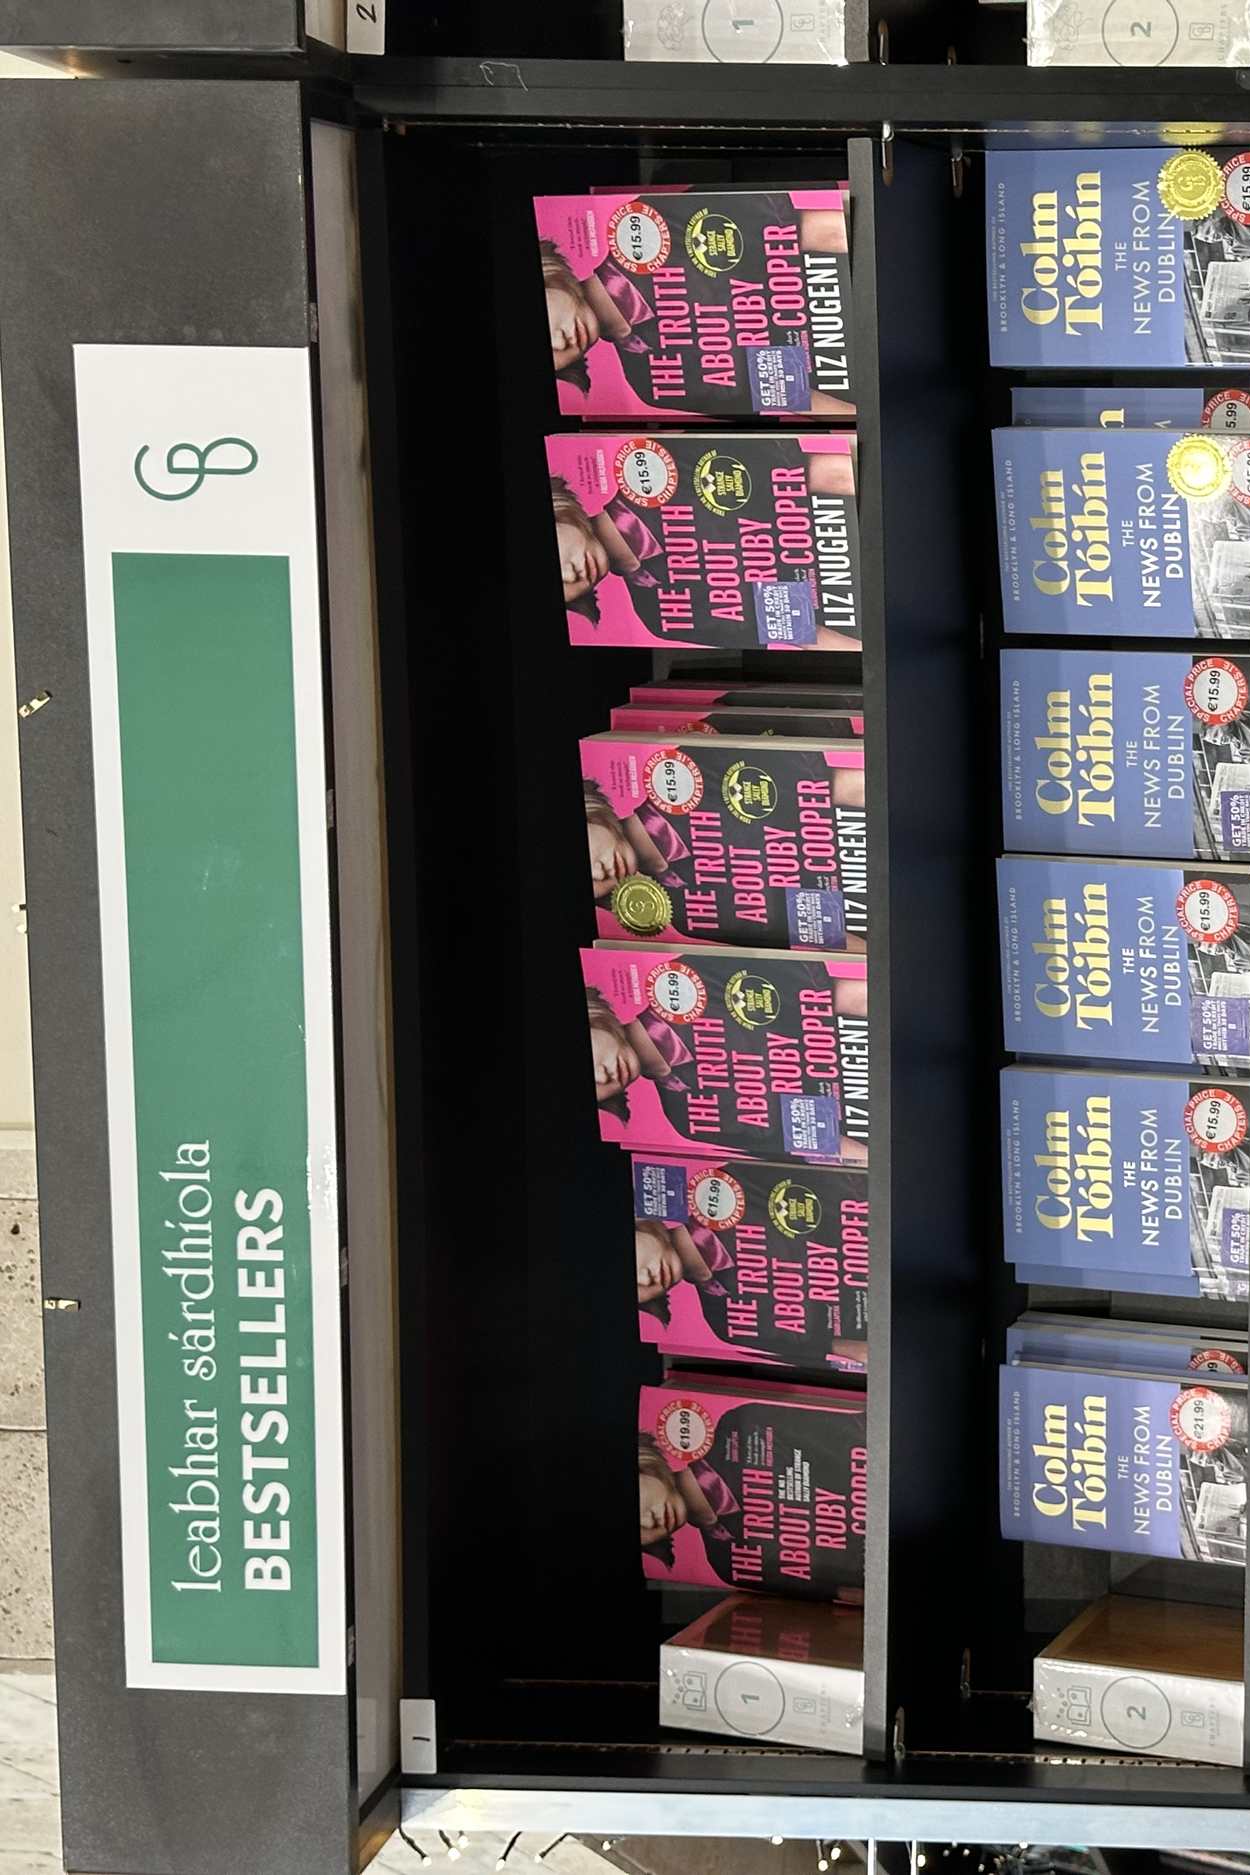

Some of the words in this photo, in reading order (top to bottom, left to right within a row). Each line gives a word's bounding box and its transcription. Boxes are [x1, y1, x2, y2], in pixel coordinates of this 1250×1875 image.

[356, 3, 378, 23] 2
[731, 19, 755, 31] 1
[1129, 21, 1152, 37] 2
[608, 205, 633, 229] PRICE
[630, 216, 643, 260] €15.99
[1132, 181, 1150, 251] FROM
[608, 231, 637, 271] SPECIAL
[763, 225, 807, 326] COOPER
[1020, 191, 1060, 325] Colm
[1062, 171, 1103, 336] Tóibín
[1115, 242, 1127, 271] THE
[1158, 212, 1175, 302] DUBLIN
[654, 267, 693, 348] TRUTH
[730, 278, 770, 346] RUBY
[804, 254, 845, 347] NUGENT
[1133, 261, 1151, 334] NEWS
[649, 354, 686, 399] THE
[694, 302, 736, 387] ABOUT
[756, 350, 768, 378] 50%
[815, 355, 849, 390] LIZ
[760, 380, 771, 406] GET
[635, 451, 652, 495] €15.99
[660, 505, 701, 583] TRUTH
[771, 467, 814, 564] COOPER
[812, 496, 852, 585] NUGENT
[703, 540, 744, 621] ABOUT
[738, 518, 777, 582] RUBY
[658, 588, 694, 631] THE
[822, 593, 856, 626] LIZ
[1143, 685, 1160, 750] FROM
[1207, 670, 1220, 712] €15.99
[664, 761, 678, 802] €15.99
[1034, 690, 1073, 815] Colm
[1075, 673, 1115, 827] Tóibín
[1127, 741, 1137, 767] THE
[1168, 715, 1185, 799] DUBLIN
[1144, 759, 1161, 827] NEWS
[1199, 892, 1210, 931] €15.99
[668, 973, 680, 1011] €15.99
[708, 1179, 719, 1218] €15.99
[159, 1140, 217, 1381] sárdhíola
[235, 1188, 291, 1591] BESTSELLERS
[1194, 1400, 1204, 1439] €21.99
[679, 1411, 691, 1449] €19.99
[1032, 1404, 1068, 1516] Colm
[1133, 1406, 1151, 1466] FROM
[1071, 1395, 1107, 1532] Tóibín
[1118, 1455, 1129, 1479] THE
[1156, 1435, 1173, 1512] DUBLIN
[167, 1399, 222, 1593] leabhar
[1134, 1471, 1151, 1535] NEWS
[741, 1692, 759, 1704] 1
[1126, 1706, 1146, 1720] 2
